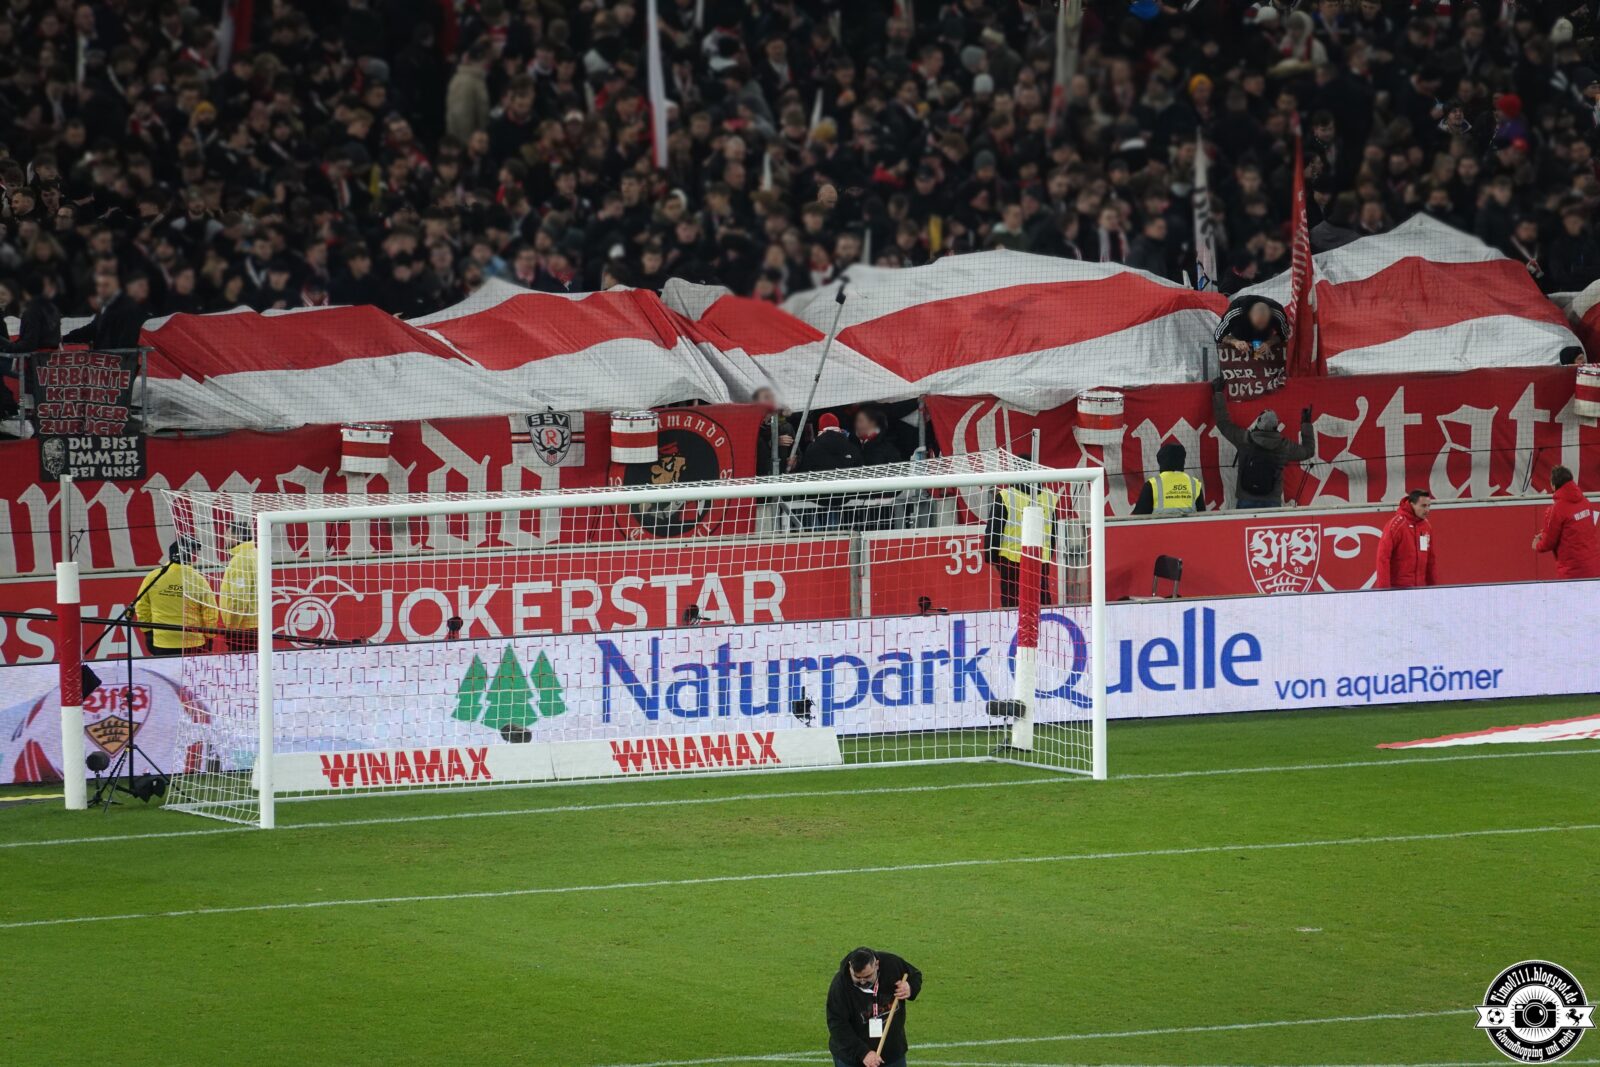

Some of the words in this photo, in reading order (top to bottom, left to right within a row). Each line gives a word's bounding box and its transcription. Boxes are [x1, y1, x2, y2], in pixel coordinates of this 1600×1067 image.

[47, 352, 122, 369] JEDER
[36, 366, 131, 389] VERBANNTE
[1222, 368, 1257, 380] DER
[531, 413, 566, 425] SSV
[68, 437, 92, 450] DU
[100, 436, 138, 450] BIST
[544, 429, 557, 446] R
[69, 450, 140, 465] IMMER
[69, 466, 95, 477] BEI
[102, 465, 140, 477] UNS!
[945, 538, 983, 576] 35
[1264, 567, 1273, 576] 18
[1293, 565, 1303, 574] 93
[368, 570, 787, 644] JOKERSTAR
[1275, 676, 1326, 700] von
[1336, 666, 1504, 702] aquaRömer
[610, 731, 781, 772] WINAMAX
[320, 747, 492, 788] WINAMAX
